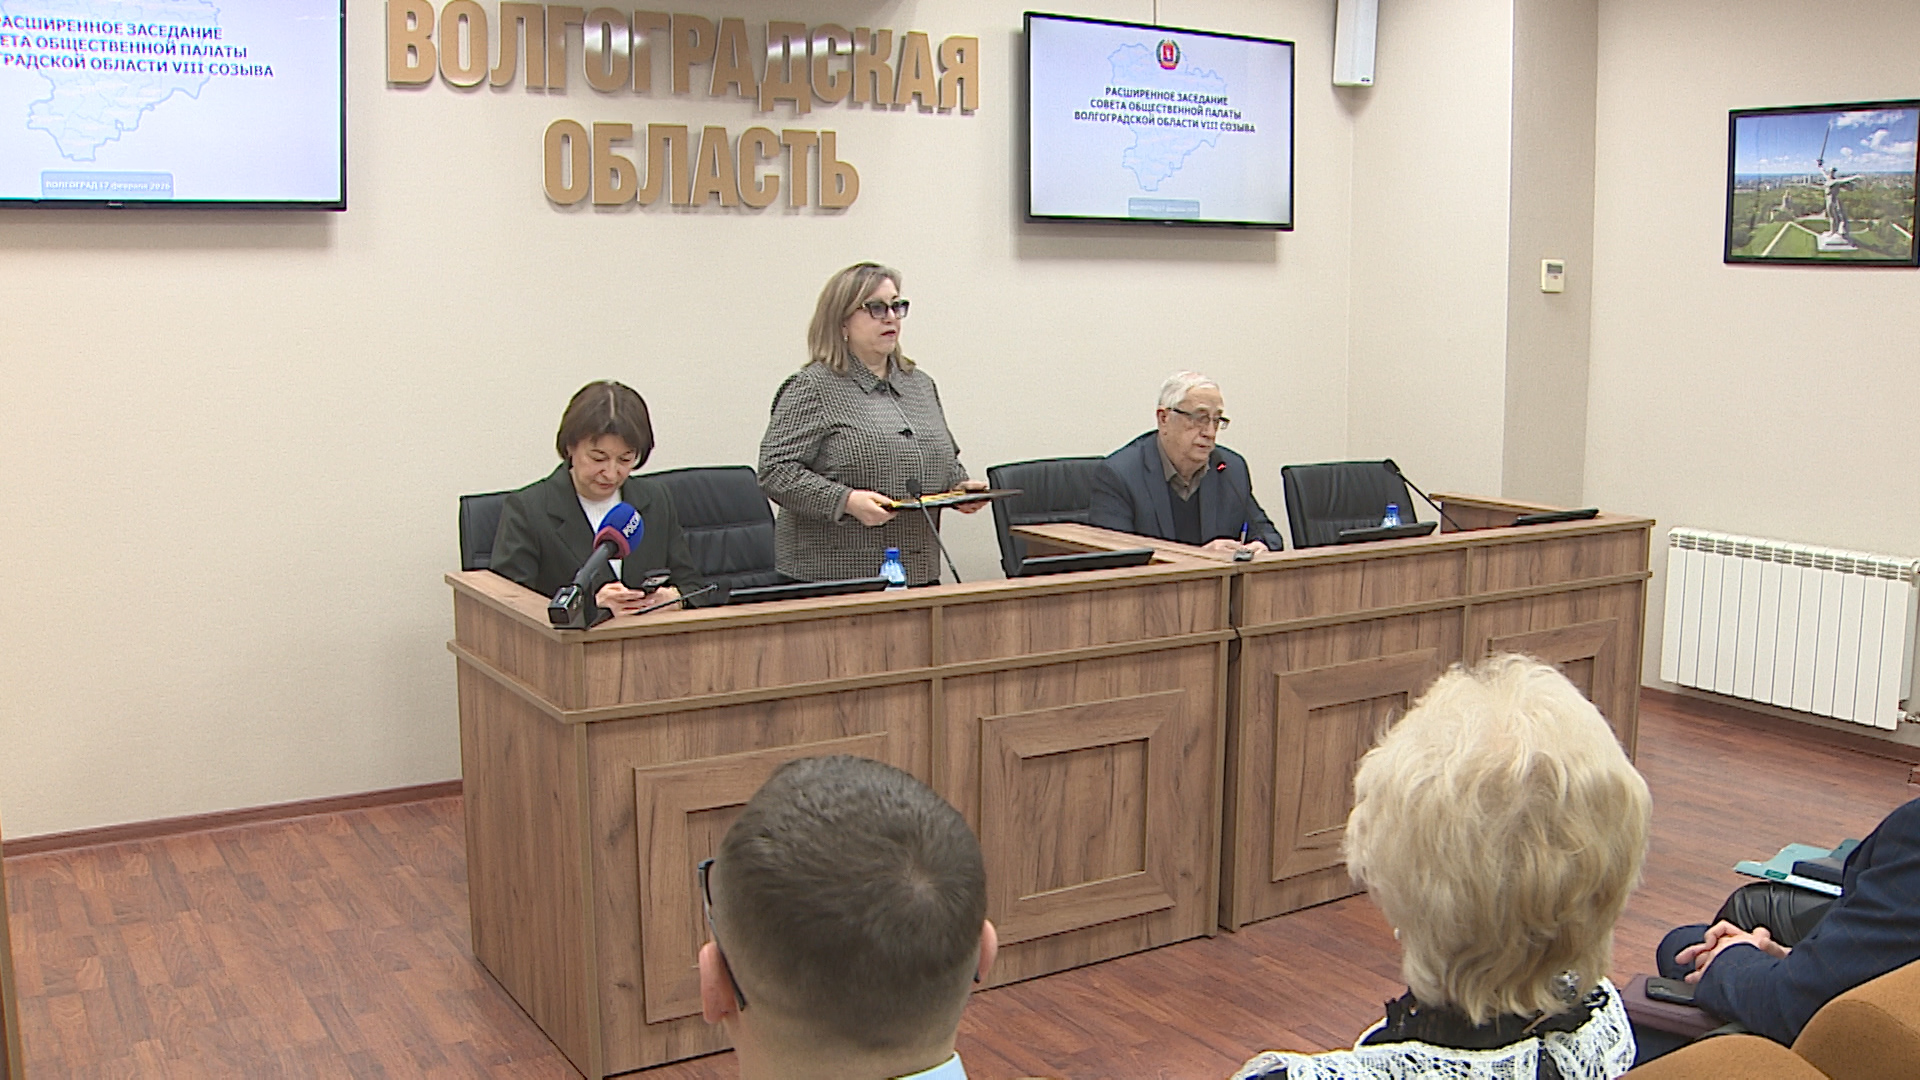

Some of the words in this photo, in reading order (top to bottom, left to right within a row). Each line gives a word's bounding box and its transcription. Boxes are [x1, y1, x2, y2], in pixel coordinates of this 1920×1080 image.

[0, 15, 123, 36] АСШИРЕННОЕ
[127, 22, 223, 40] ЗАСЕДАНИЕ
[36, 35, 176, 56] ОБЩЕСТВЕННОЙ
[180, 43, 248, 58] ПАЛАТЫ
[386, 0, 980, 114] ВОЛГОГРАДСКАЯ
[90, 57, 168, 73] ОБЛАСТИ
[172, 61, 204, 74] VIII
[208, 63, 274, 77] СОЗЫВА
[1105, 86, 1175, 102] РАСШИРЕННОЕ
[1177, 93, 1229, 106] ЗАСЕДАНИЕ
[1090, 98, 1127, 110] СОВЕТА
[1128, 101, 1204, 117] ОБЩЕСТВЕННОЙ
[1205, 107, 1242, 120] ПАЛАТЫ
[1074, 111, 1155, 126] ВОЛГОГРАДСКОЙ
[1157, 117, 1199, 128] ОБЛАСТИ
[1201, 120, 1218, 130] VIII
[1219, 121, 1256, 133] СОЗЫВА
[542, 118, 861, 209] ОБЛАСТЬ
[45, 180, 98, 191] ВОЛГОГРАД
